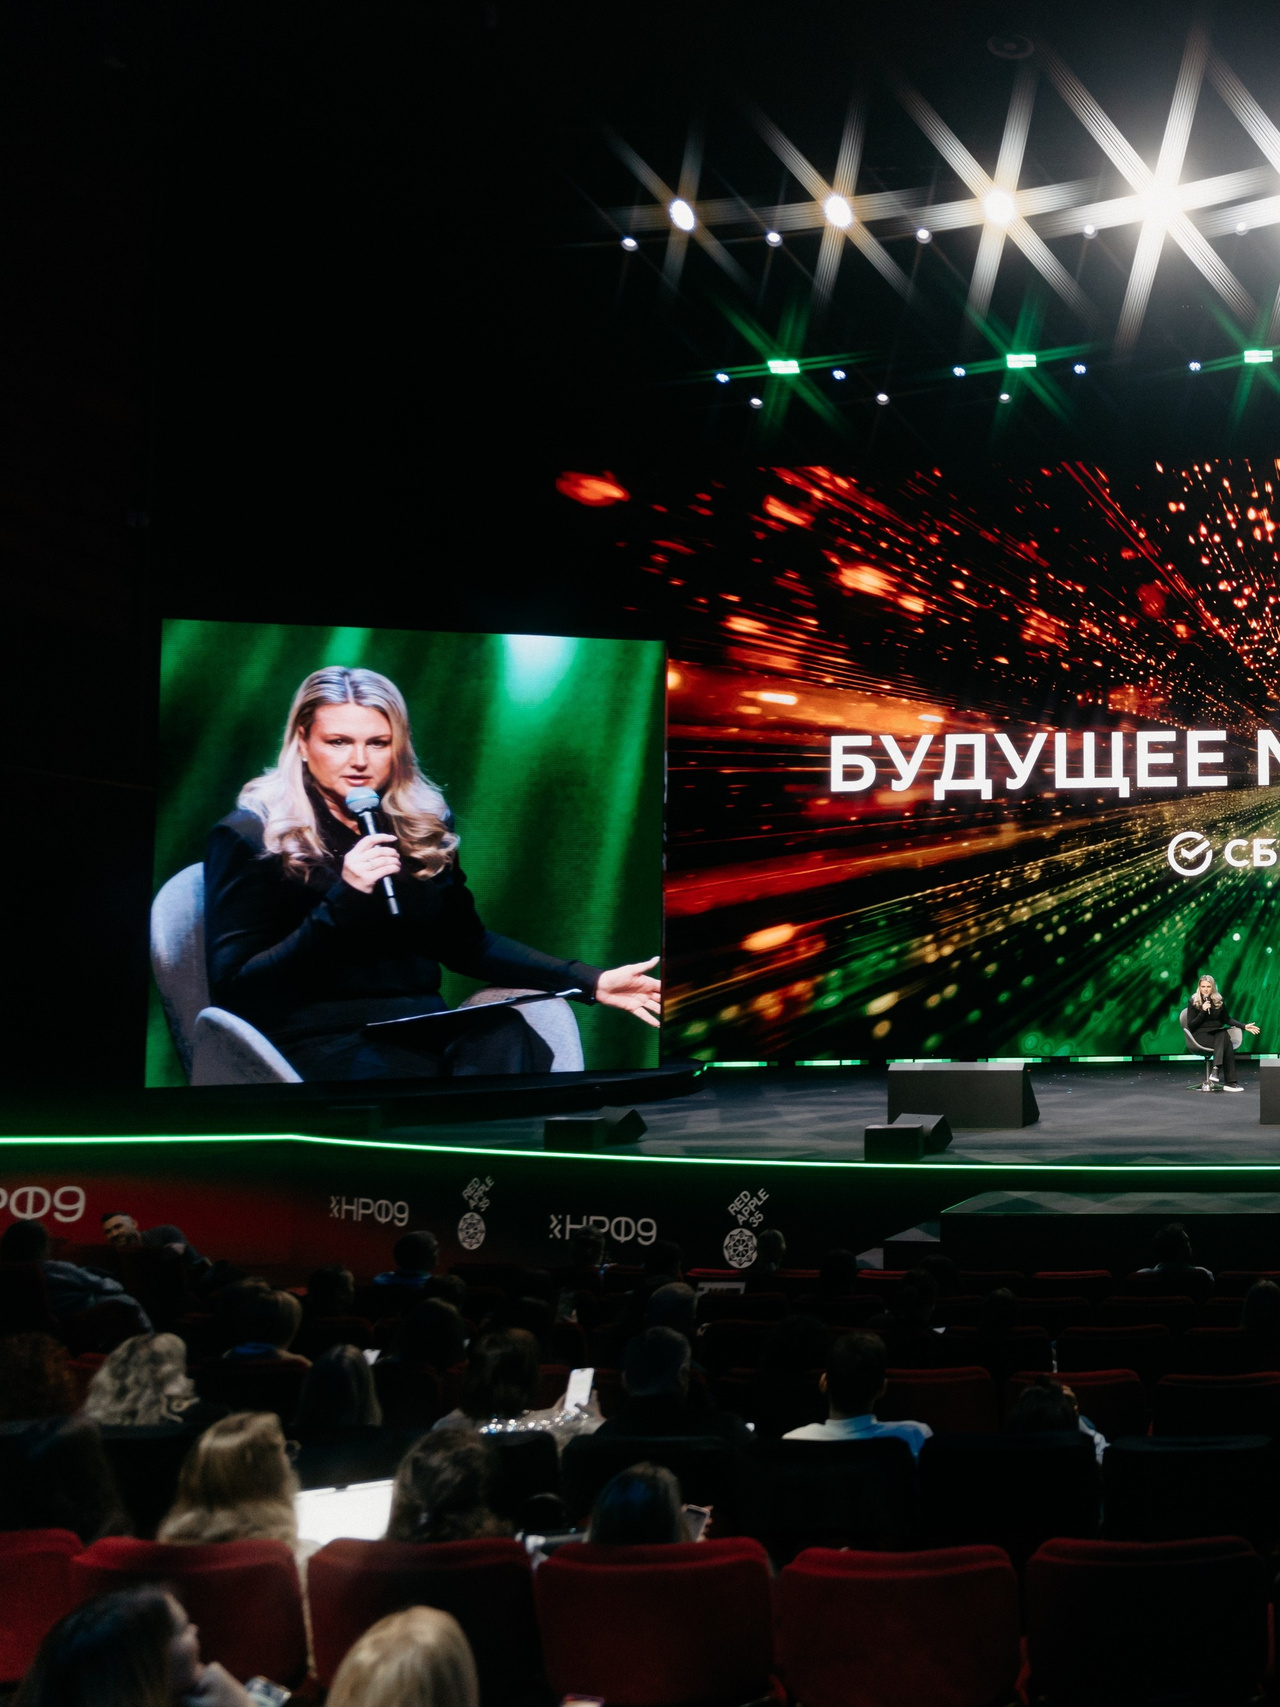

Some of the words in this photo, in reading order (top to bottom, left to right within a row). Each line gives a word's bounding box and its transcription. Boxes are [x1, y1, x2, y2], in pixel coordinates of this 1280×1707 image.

[829, 729, 1228, 801] БУДУЩЕЕ
[728, 1190, 751, 1217] RED
[736, 1187, 770, 1226] APPLE
[749, 1210, 764, 1228] 35
